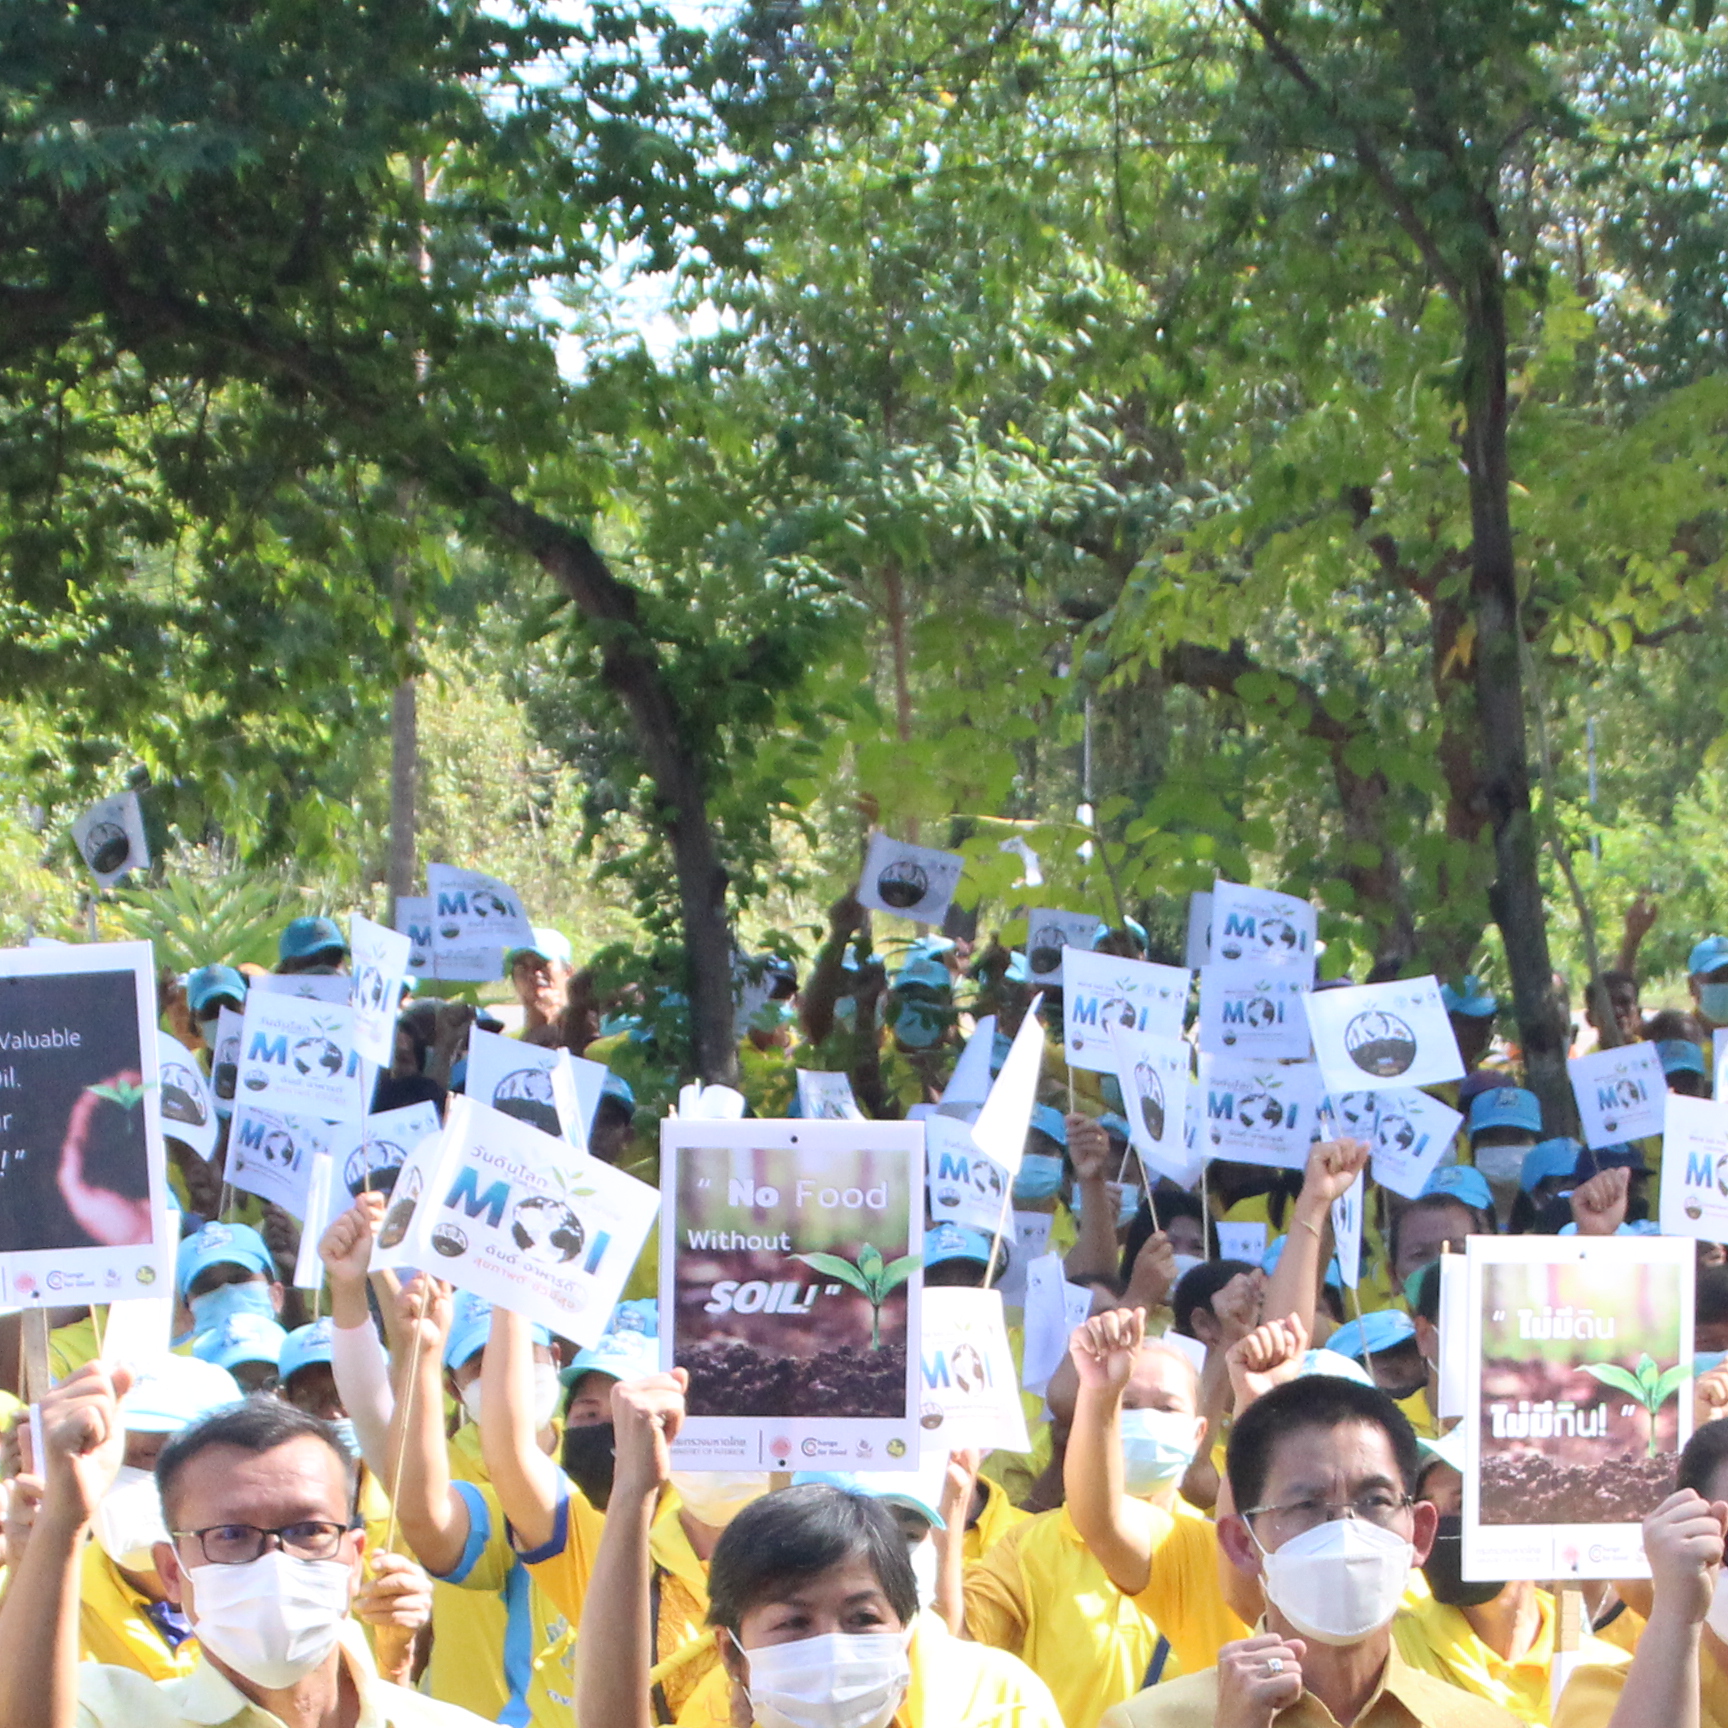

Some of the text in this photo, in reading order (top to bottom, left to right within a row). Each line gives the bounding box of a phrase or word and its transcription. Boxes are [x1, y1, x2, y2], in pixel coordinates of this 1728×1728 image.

[1379, 1113, 1431, 1158] OI
[728, 1179, 780, 1209] No
[795, 1180, 889, 1210] Food
[443, 1164, 611, 1277] MOI
[687, 1229, 792, 1251] Without
[704, 1280, 818, 1315] SOIL!
